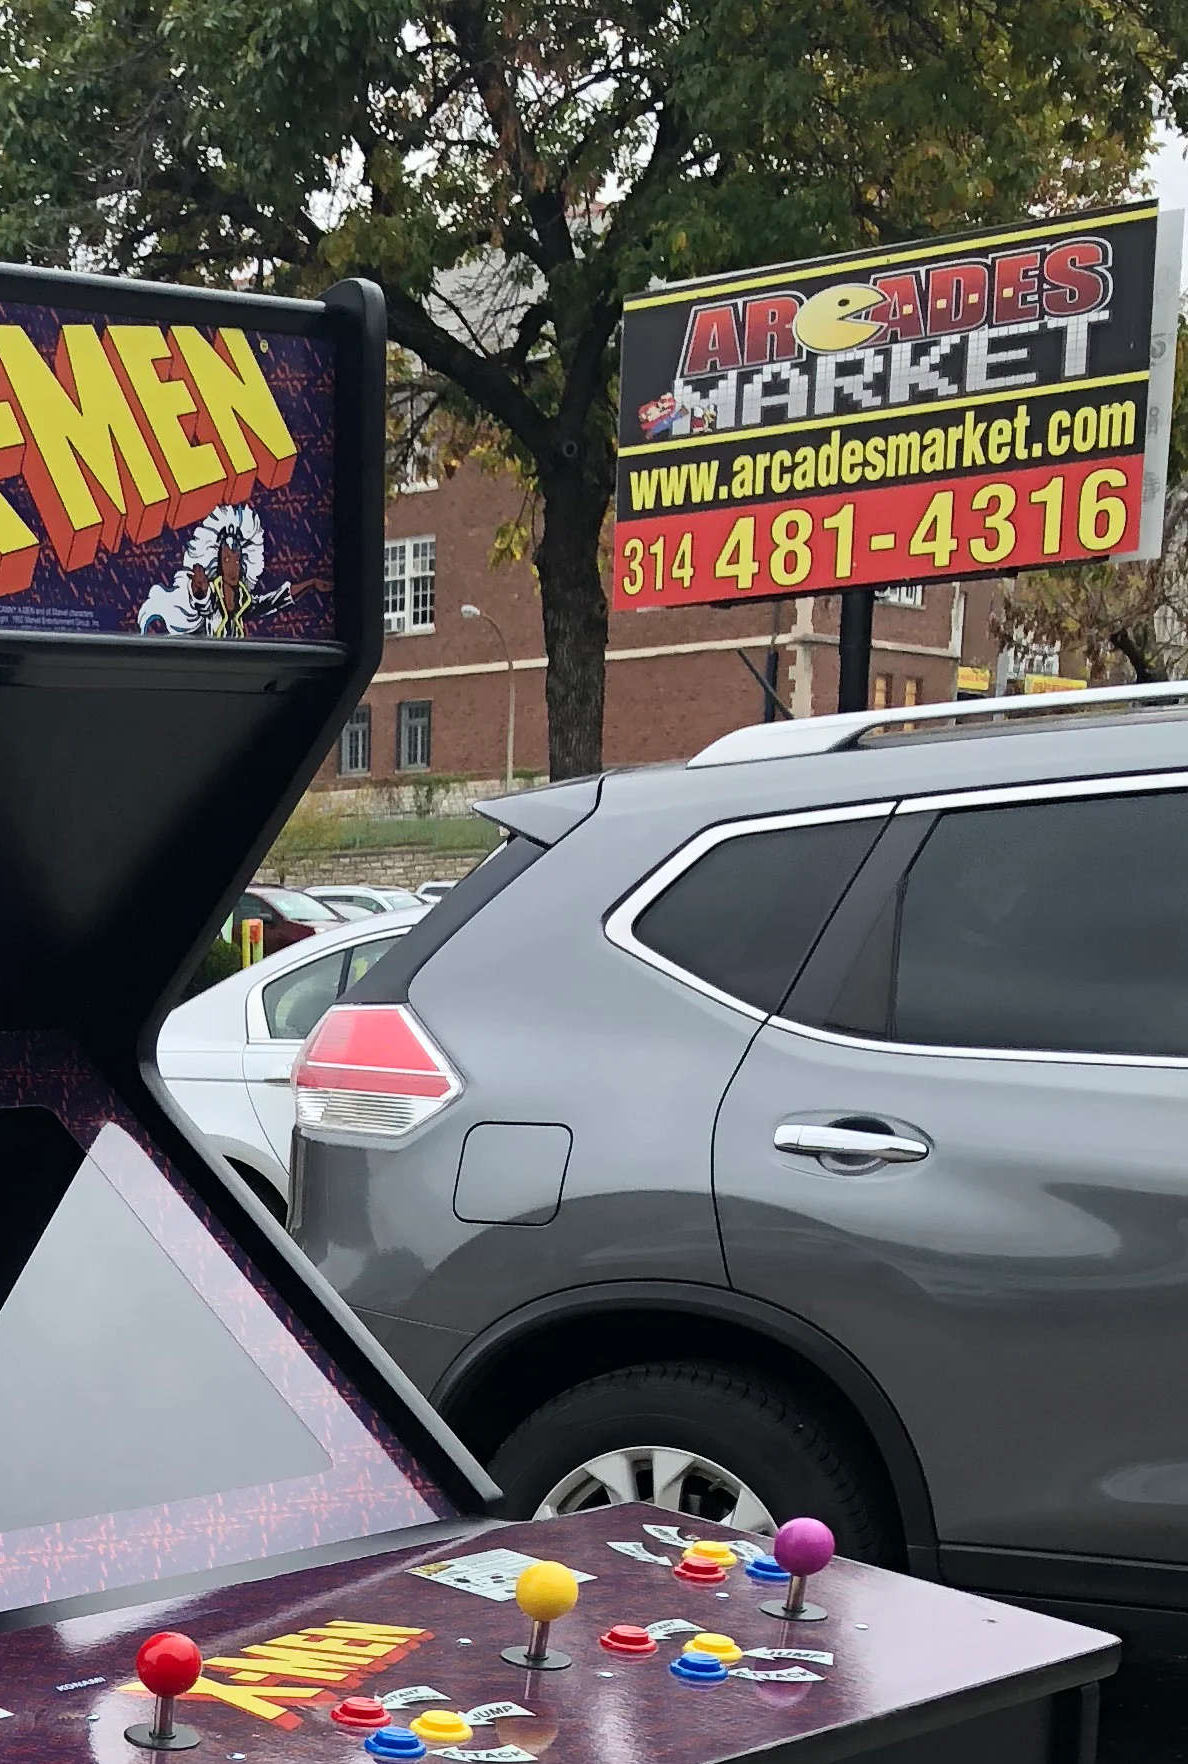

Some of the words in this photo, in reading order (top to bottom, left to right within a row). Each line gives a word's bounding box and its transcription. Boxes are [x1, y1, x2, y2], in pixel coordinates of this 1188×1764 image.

[672, 310, 1110, 436] MARKET
[629, 400, 1137, 511] www.arcadesmarket.com
[621, 532, 694, 596] 314
[714, 467, 1129, 592] 481-4316
[762, 1650, 827, 1660] JUMP
[115, 1620, 436, 1732] X-MEN
[735, 1669, 814, 1679] ATTACK
[55, 1676, 107, 1692] KONAMI
[472, 1705, 514, 1722] JUMP
[442, 1749, 526, 1759] ATTACK
